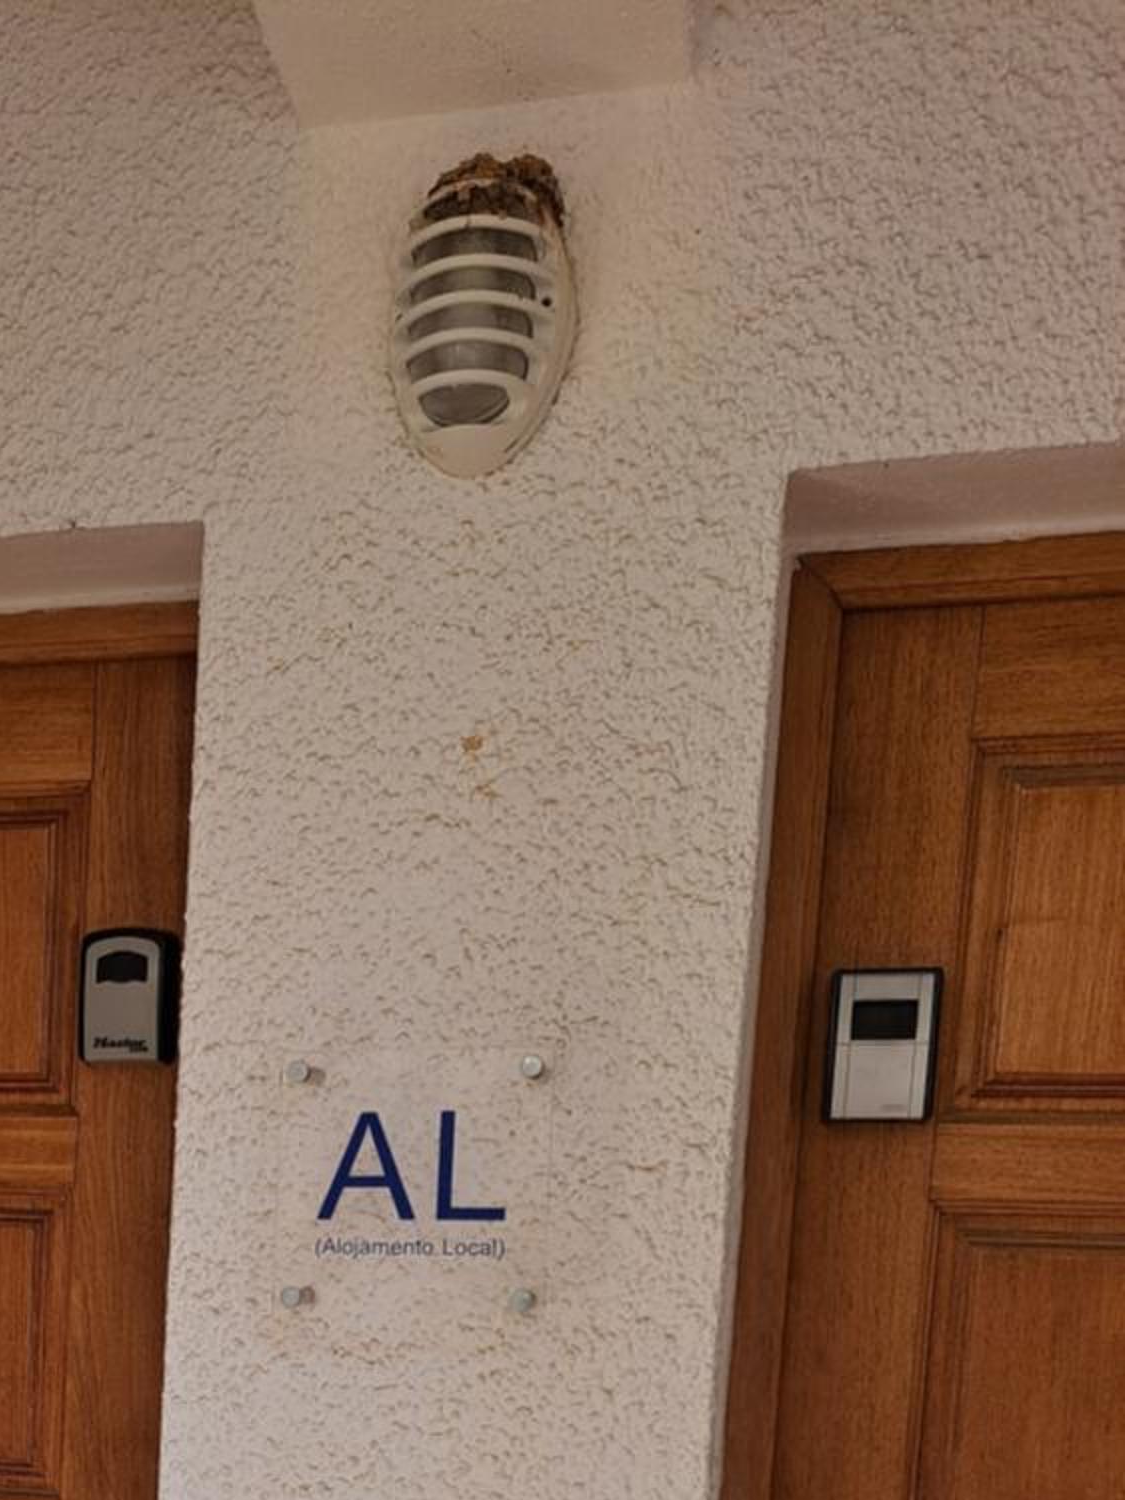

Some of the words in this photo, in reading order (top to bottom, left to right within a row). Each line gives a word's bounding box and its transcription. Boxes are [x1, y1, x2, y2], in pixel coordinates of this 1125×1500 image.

[317, 1110, 506, 1221] AL
[315, 1238, 434, 1260] (Alojamento
[442, 1238, 506, 1261] Local)
